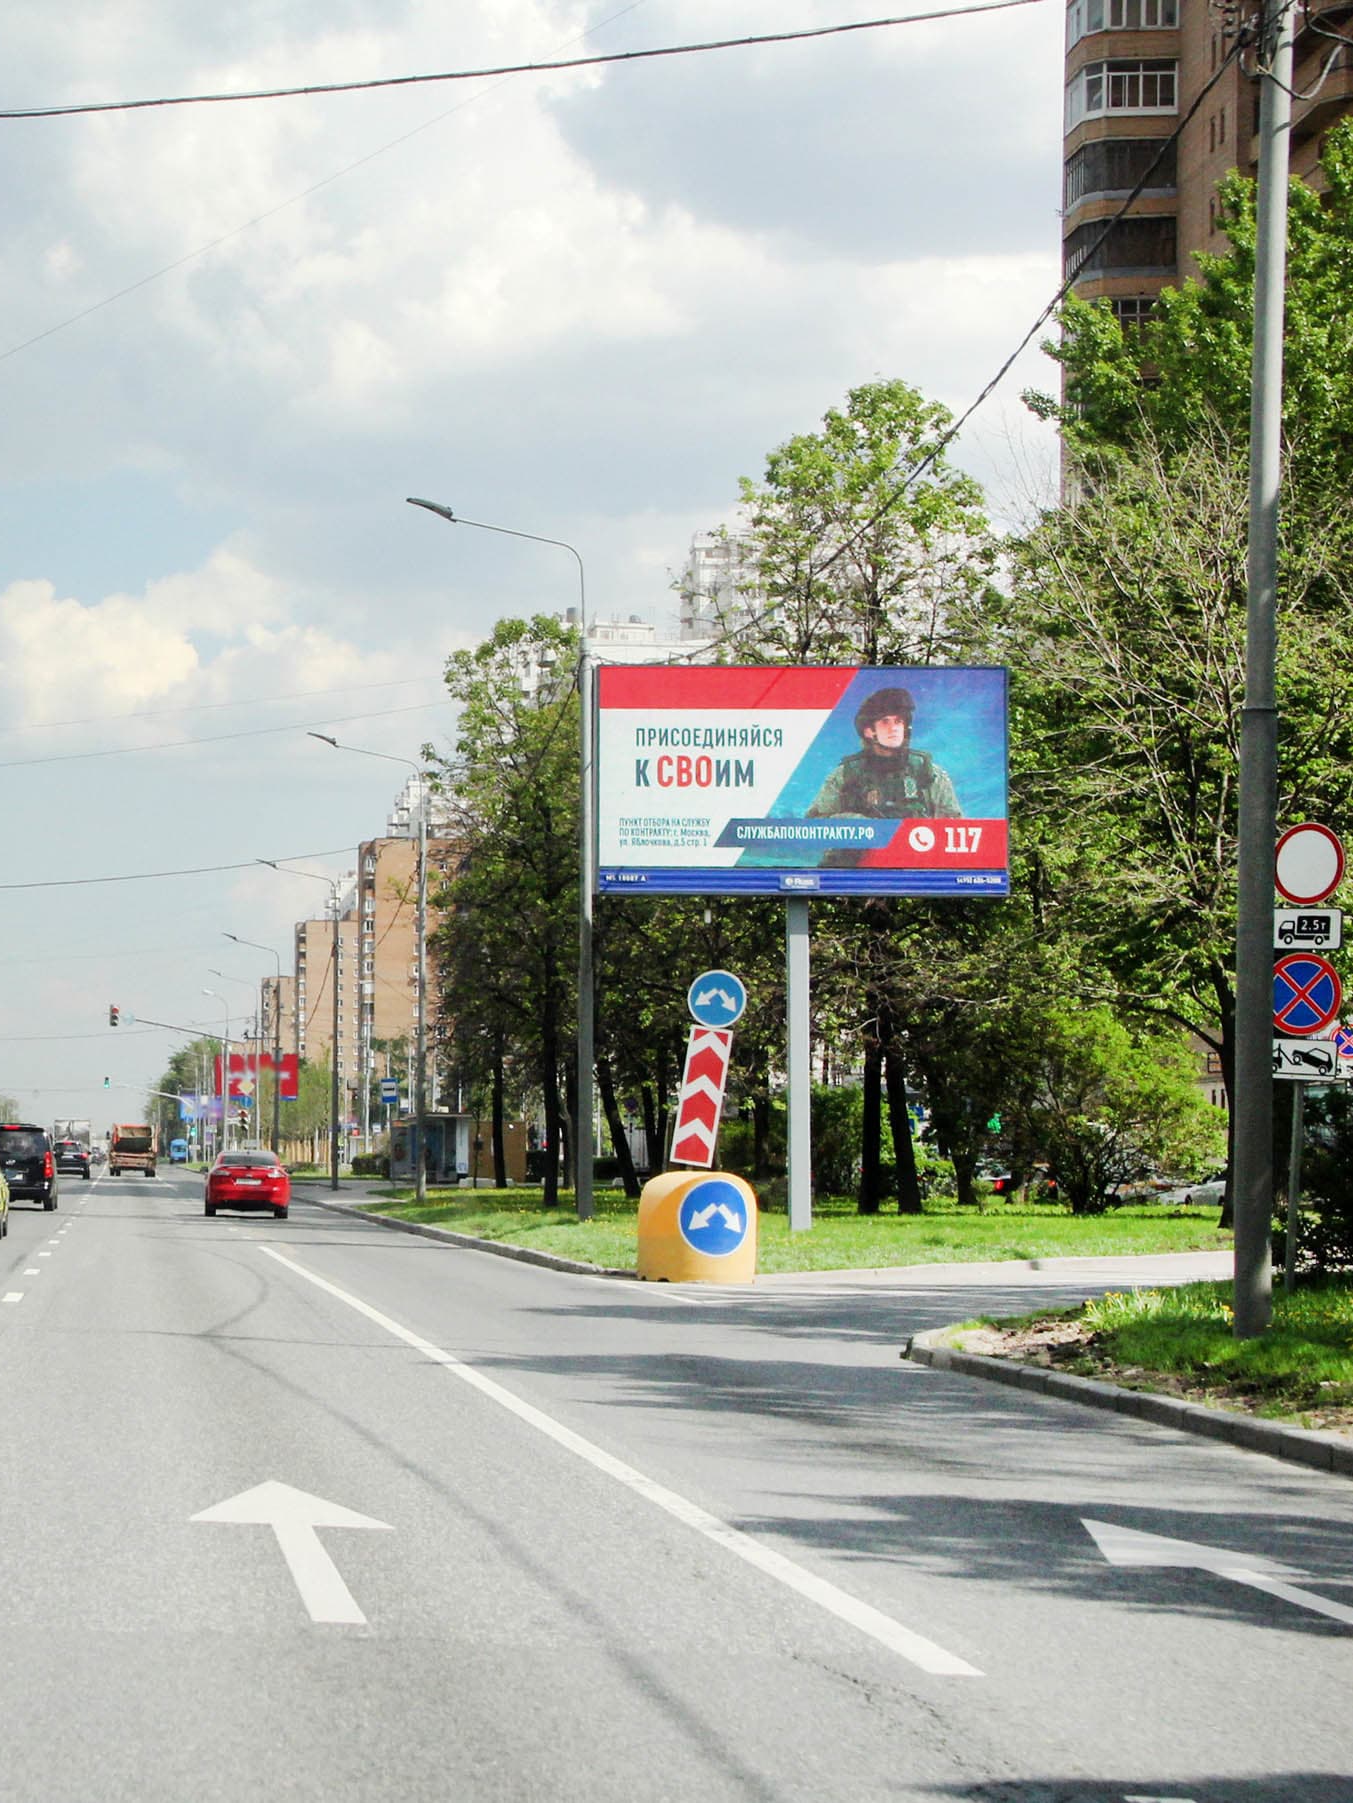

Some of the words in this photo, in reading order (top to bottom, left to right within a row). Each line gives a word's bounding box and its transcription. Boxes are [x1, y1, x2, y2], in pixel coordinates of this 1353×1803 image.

[635, 724, 784, 749] ПРИСОЕДИНЯЙСЯ
[635, 759, 650, 787] К
[657, 755, 754, 788] СВОИМ
[671, 817, 681, 827] НА
[736, 825, 875, 840] СЛУЖБАПОКОНТРАКТУ.РФ
[944, 826, 983, 853] 117
